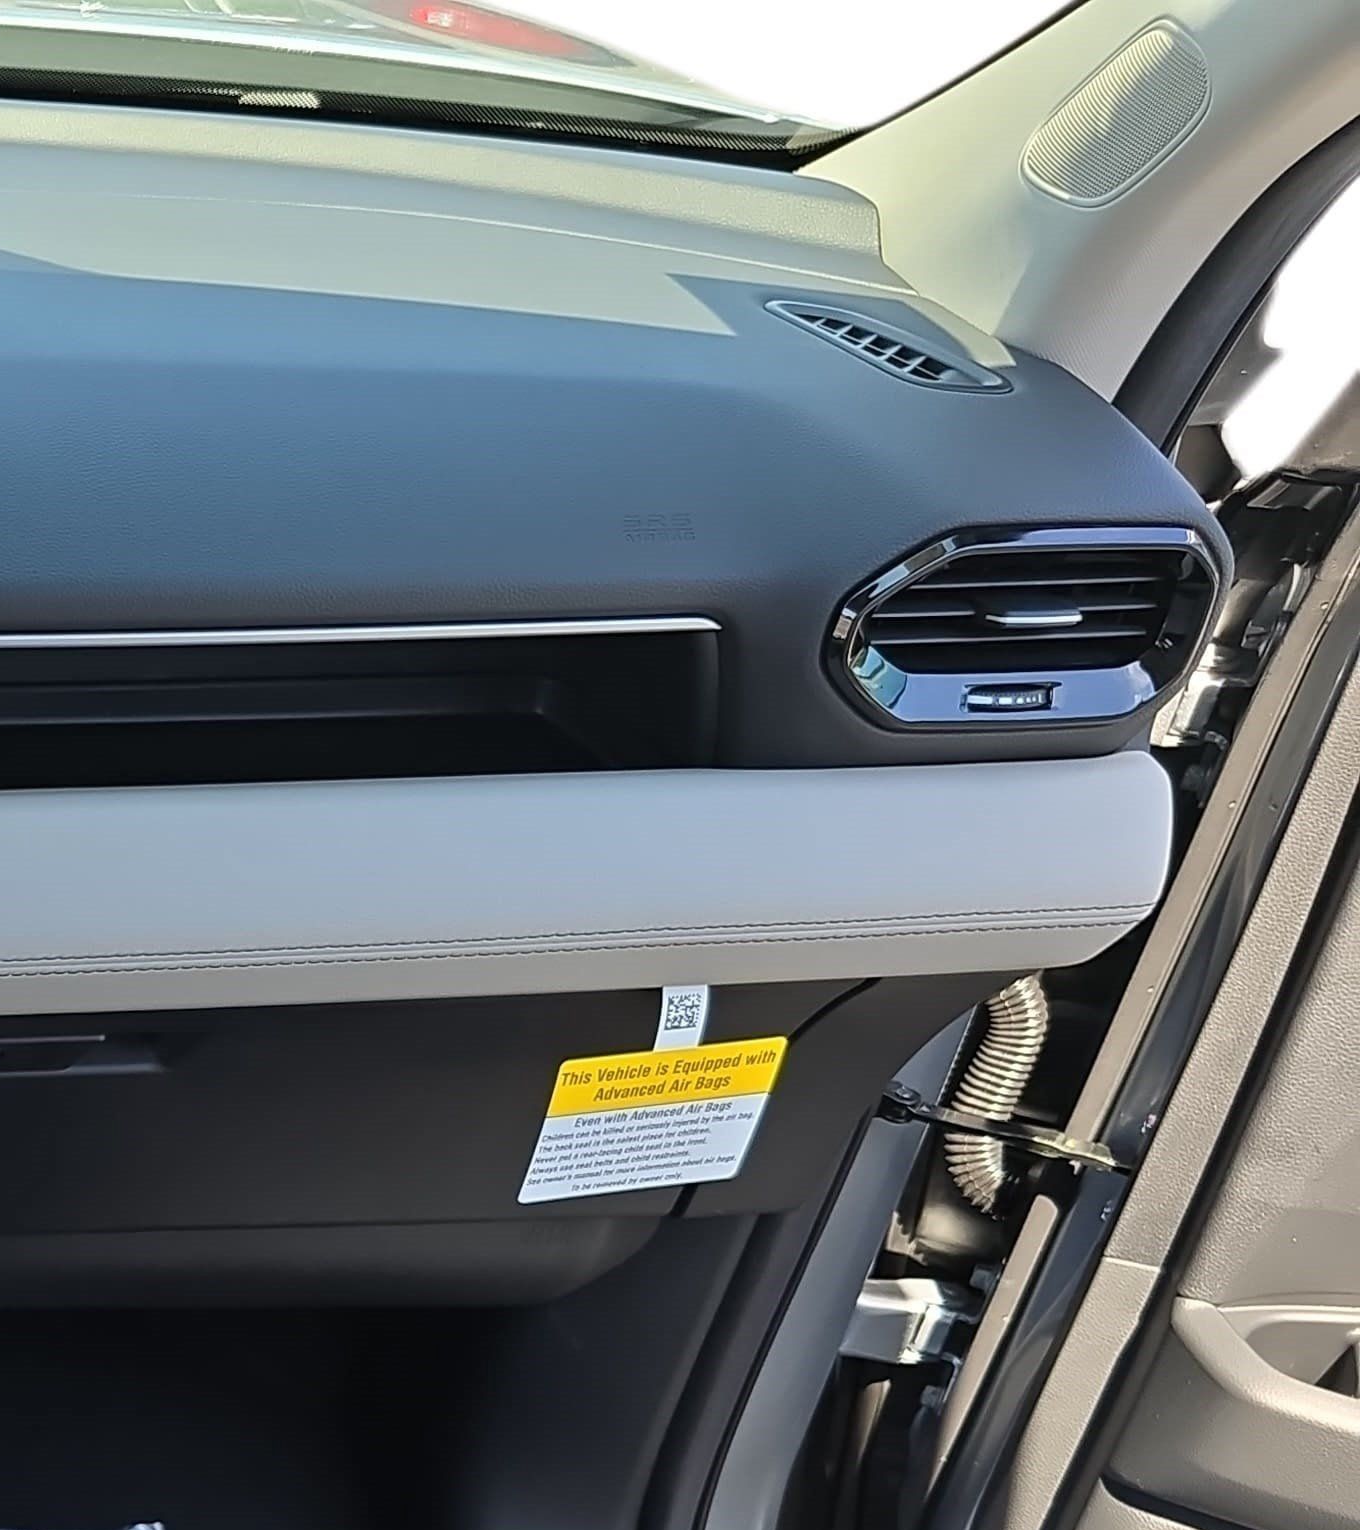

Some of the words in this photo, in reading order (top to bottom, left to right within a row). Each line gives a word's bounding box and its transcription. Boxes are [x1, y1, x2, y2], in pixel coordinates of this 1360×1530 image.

[561, 1072, 592, 1087] This
[597, 1064, 652, 1083] Vehicle
[655, 1062, 669, 1076] is
[673, 1054, 741, 1075] Equipped
[745, 1050, 776, 1066] with
[593, 1080, 666, 1102] Advanced
[668, 1078, 691, 1094] Air
[695, 1074, 731, 1092] Bags
[574, 1116, 601, 1128] Even
[604, 1112, 628, 1124] with
[630, 1105, 684, 1121] Advanced
[685, 1103, 703, 1115] Air
[704, 1102, 732, 1113] Bags
